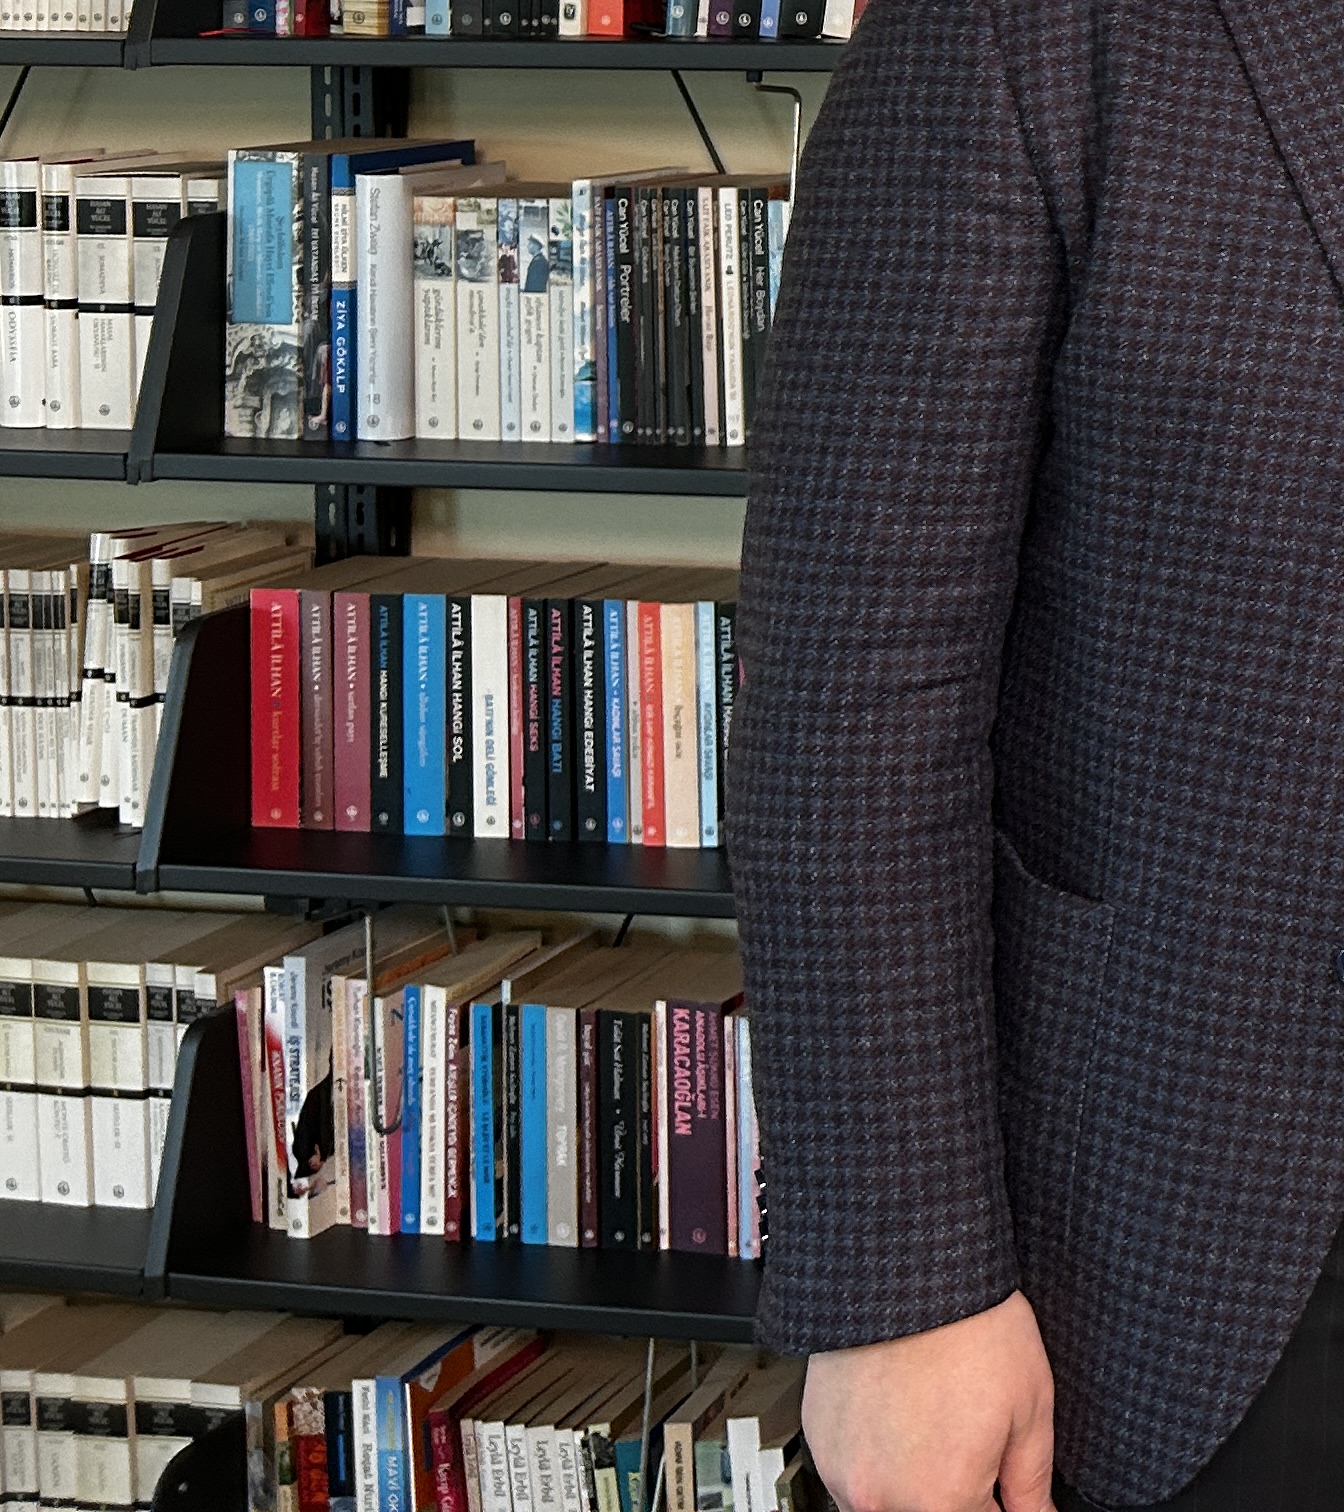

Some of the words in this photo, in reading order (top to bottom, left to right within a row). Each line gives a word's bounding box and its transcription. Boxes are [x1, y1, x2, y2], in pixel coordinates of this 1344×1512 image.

[618, 199, 630, 217] Can
[617, 220, 631, 254] Yücel
[619, 264, 633, 323] Portreler
[336, 301, 347, 330] ZİYA
[336, 336, 348, 393] GÖKALP
[452, 736, 463, 762] SOL
